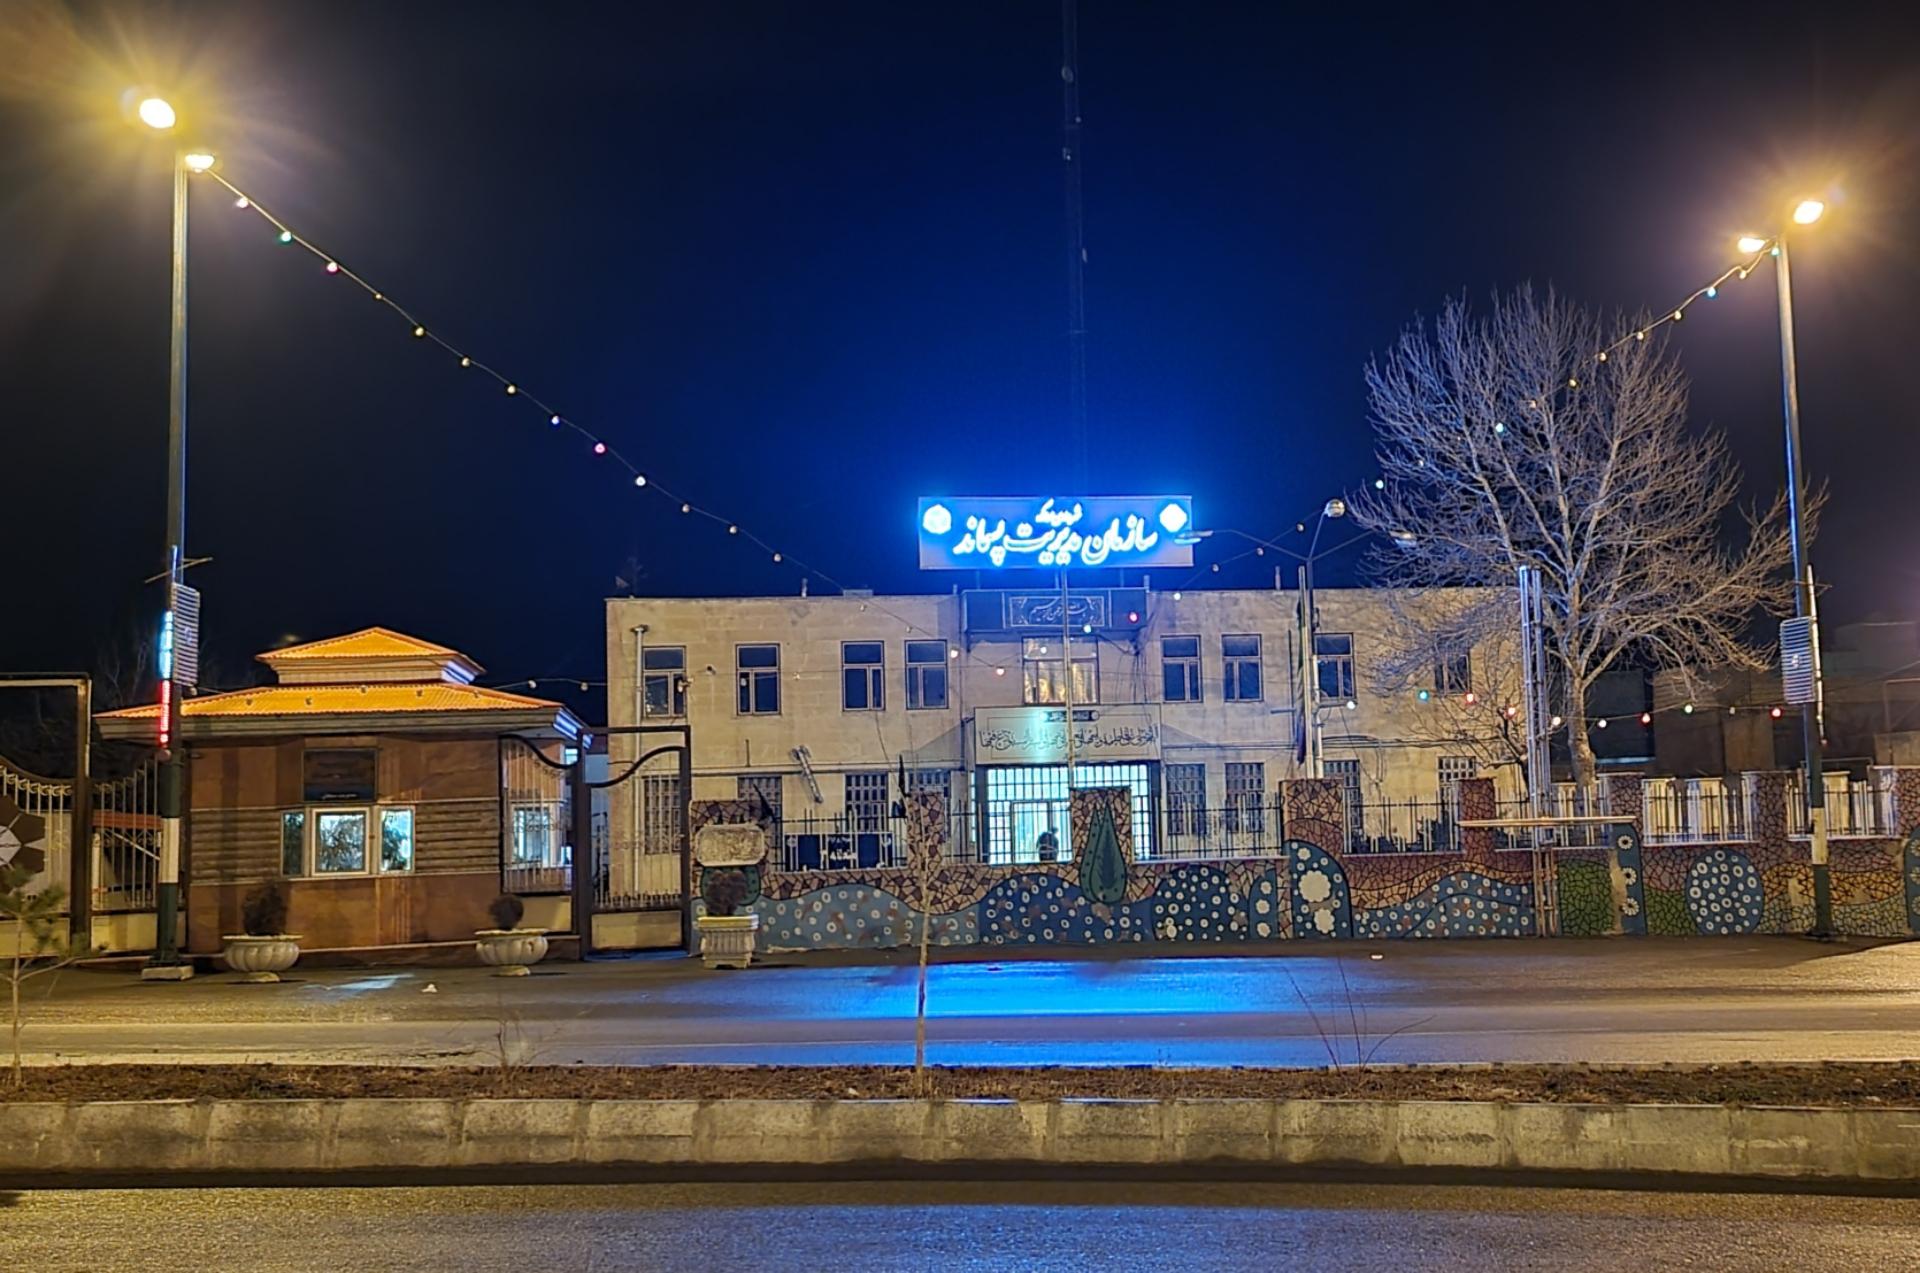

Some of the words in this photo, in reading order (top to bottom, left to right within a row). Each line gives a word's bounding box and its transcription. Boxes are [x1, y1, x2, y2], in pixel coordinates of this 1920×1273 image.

[952, 515, 1006, 567] پسماند
[1003, 522, 1082, 565] مدیریت
[1080, 513, 1158, 565] سازمان
